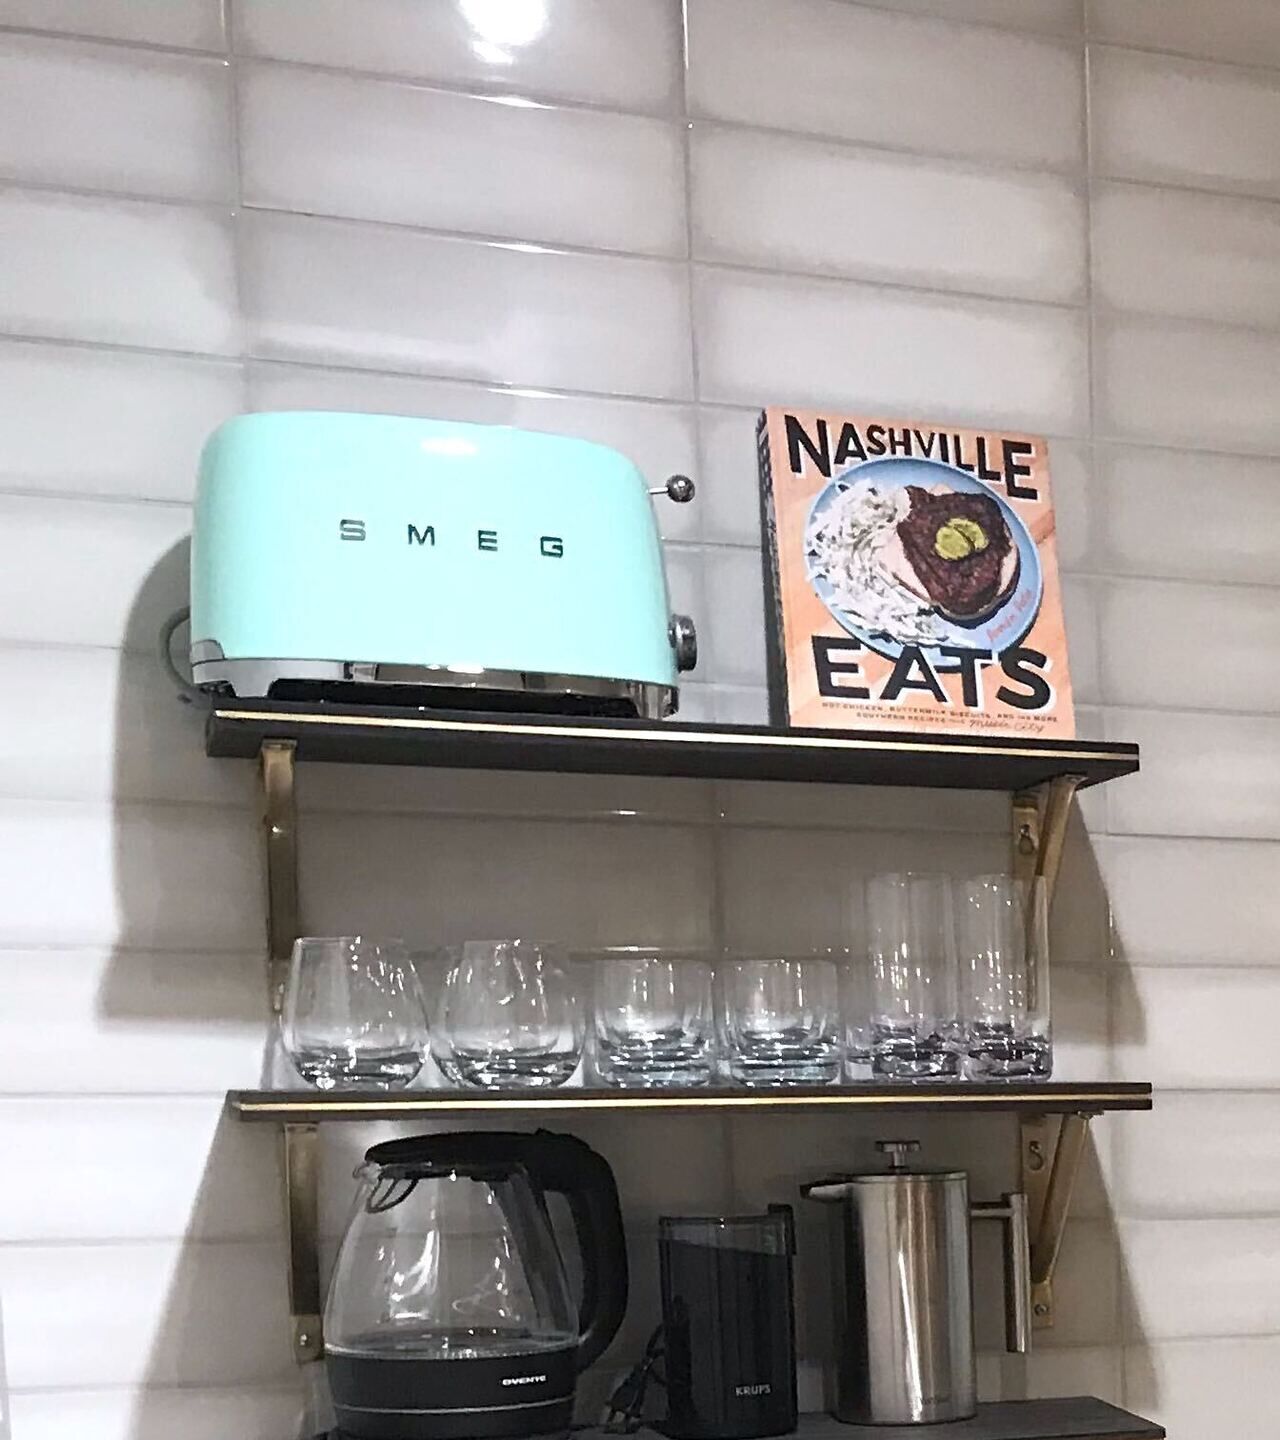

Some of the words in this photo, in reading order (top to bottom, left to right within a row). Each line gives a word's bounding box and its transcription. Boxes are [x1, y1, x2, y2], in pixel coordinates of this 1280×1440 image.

[784, 414, 1038, 500] NASHVILLE
[340, 519, 564, 559] SMEG
[811, 635, 1051, 710] EATS
[735, 1384, 771, 1397] KRUPS
